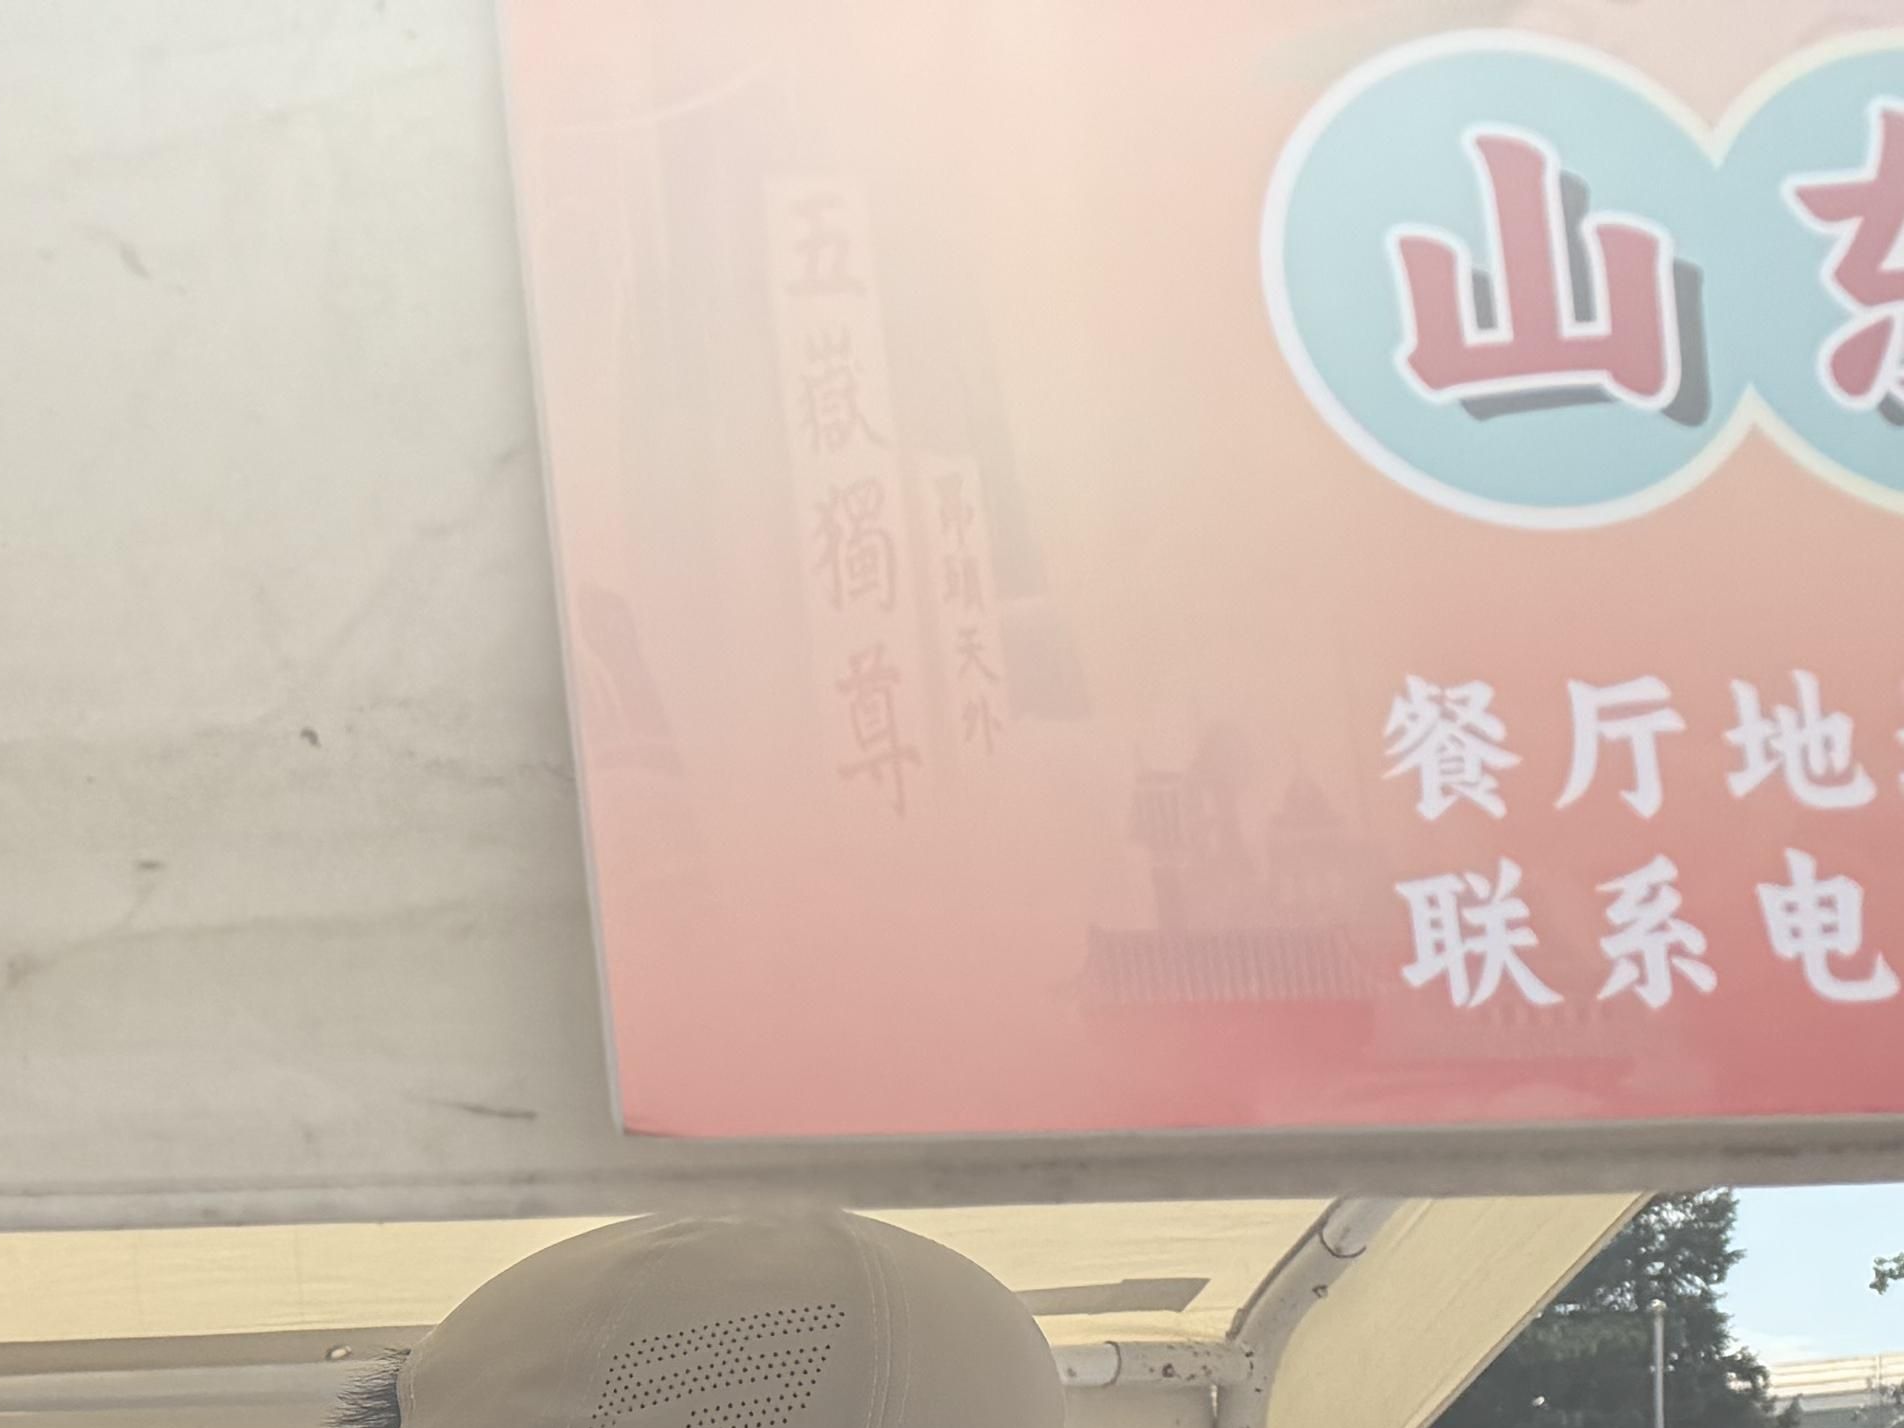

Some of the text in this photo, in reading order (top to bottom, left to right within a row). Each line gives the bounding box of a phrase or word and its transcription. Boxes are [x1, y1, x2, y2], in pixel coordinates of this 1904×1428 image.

[1380, 668, 1904, 820] 餐厅地
[1394, 847, 1902, 1010] 联系电
